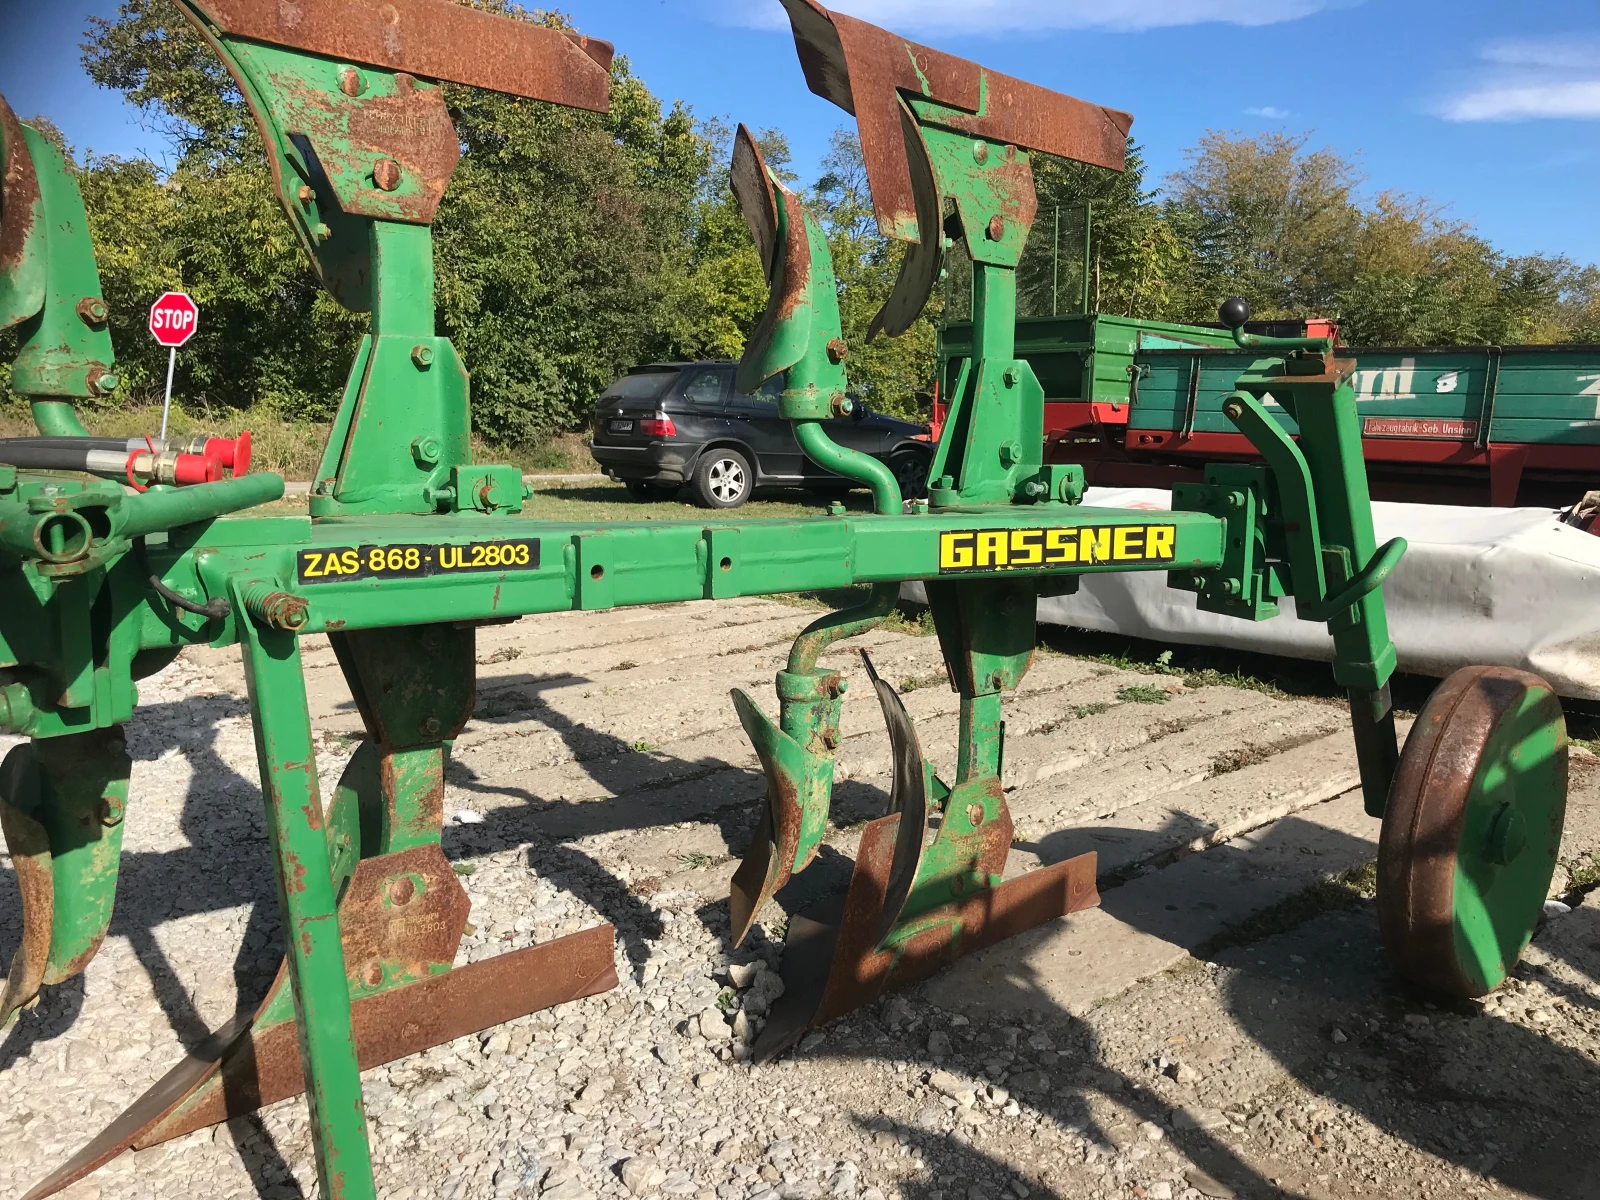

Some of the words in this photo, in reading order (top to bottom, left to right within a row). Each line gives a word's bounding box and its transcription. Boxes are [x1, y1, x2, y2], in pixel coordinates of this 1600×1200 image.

[153, 308, 194, 330] STOP
[439, 544, 530, 567] UL2803
[940, 526, 1175, 568] GASSNER
